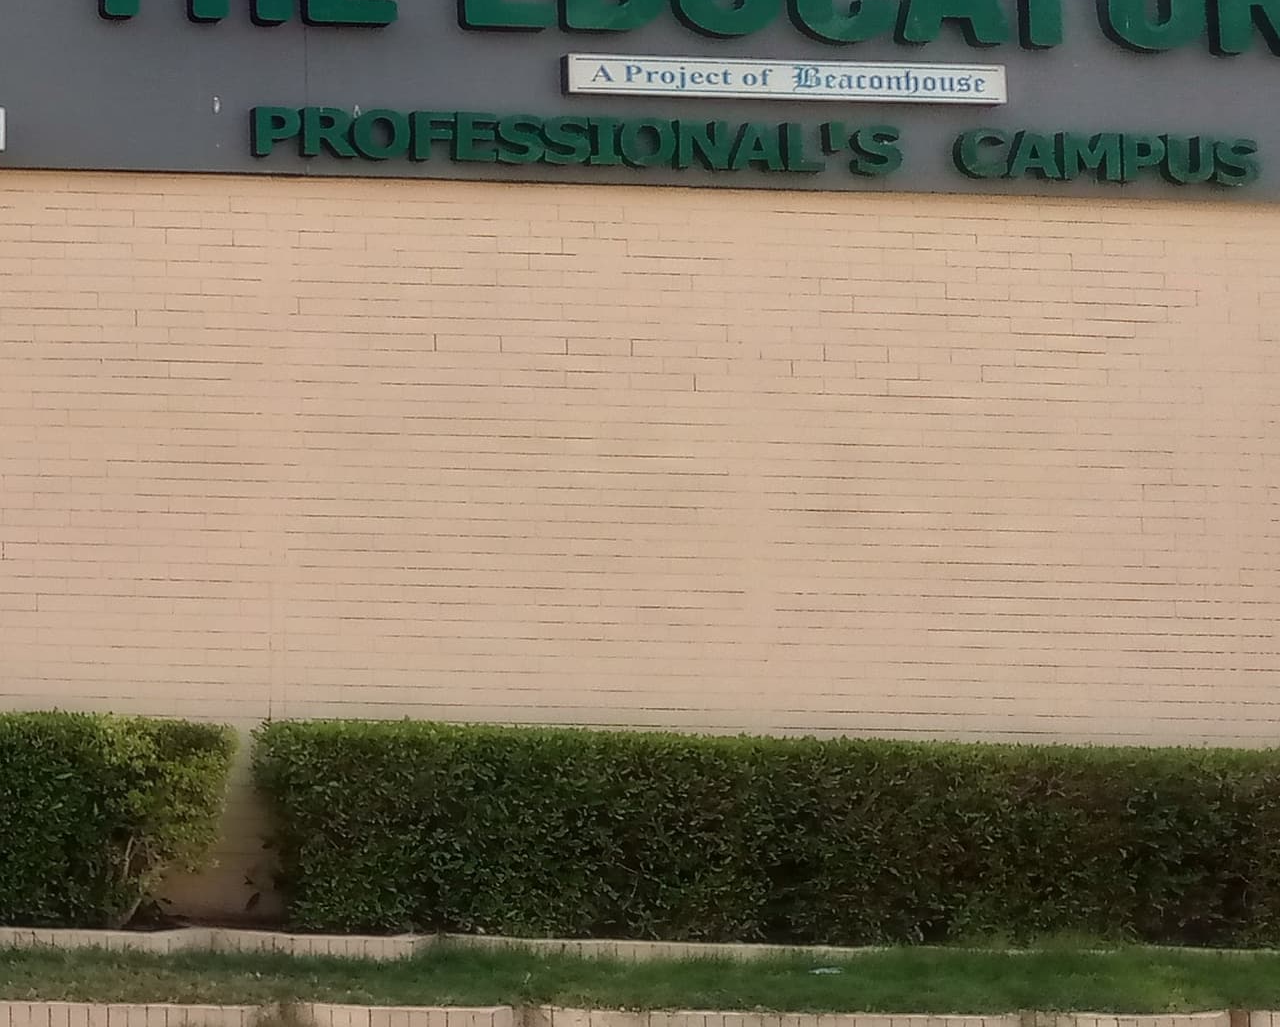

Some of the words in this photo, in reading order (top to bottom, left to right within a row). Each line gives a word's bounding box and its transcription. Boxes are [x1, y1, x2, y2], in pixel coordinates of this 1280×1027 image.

[591, 64, 613, 82] A
[625, 65, 732, 90] Project
[743, 69, 773, 86] of
[792, 66, 986, 94] Beaconhouse
[952, 128, 1262, 186] CAMPUS
